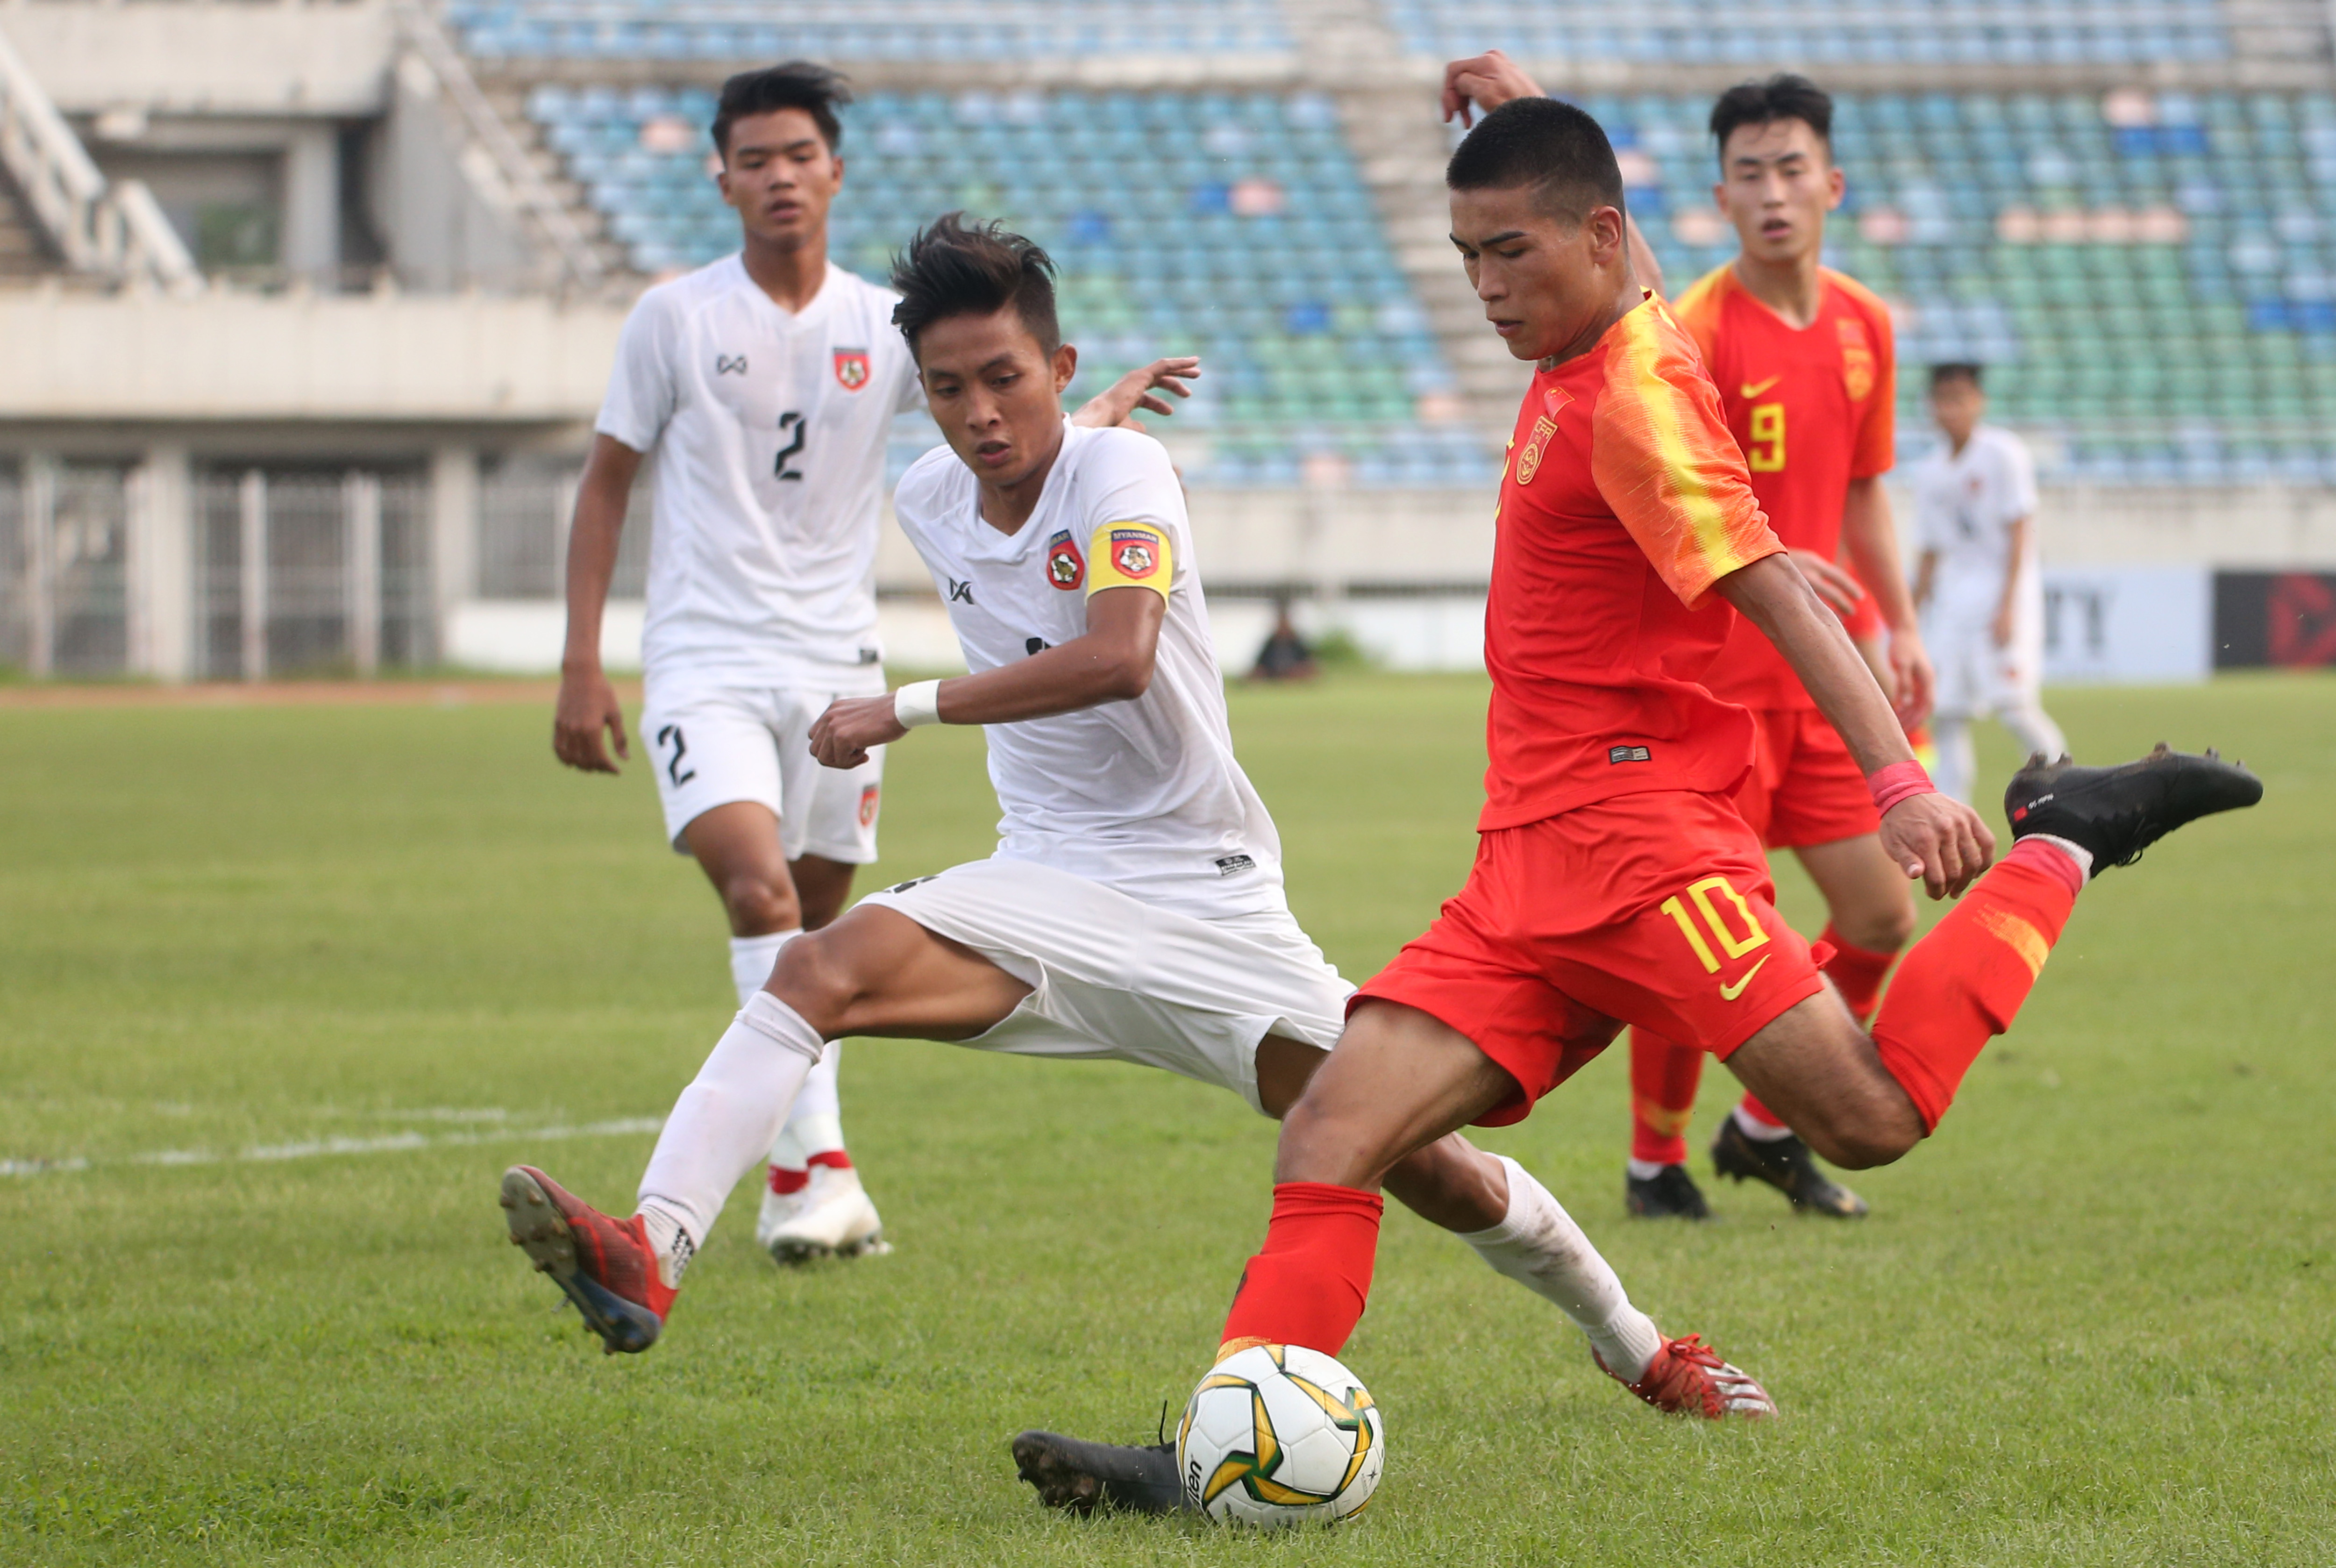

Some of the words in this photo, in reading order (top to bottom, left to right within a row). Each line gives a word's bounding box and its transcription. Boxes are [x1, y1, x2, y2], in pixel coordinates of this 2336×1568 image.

[774, 413, 805, 481] 2
[1534, 421, 1553, 439] CFA
[1751, 404, 1786, 472] 9
[1113, 531, 1157, 542] MYANMAR
[658, 725, 696, 788] 2
[1660, 877, 1770, 974] 10
[1188, 1461, 1202, 1505] lten
